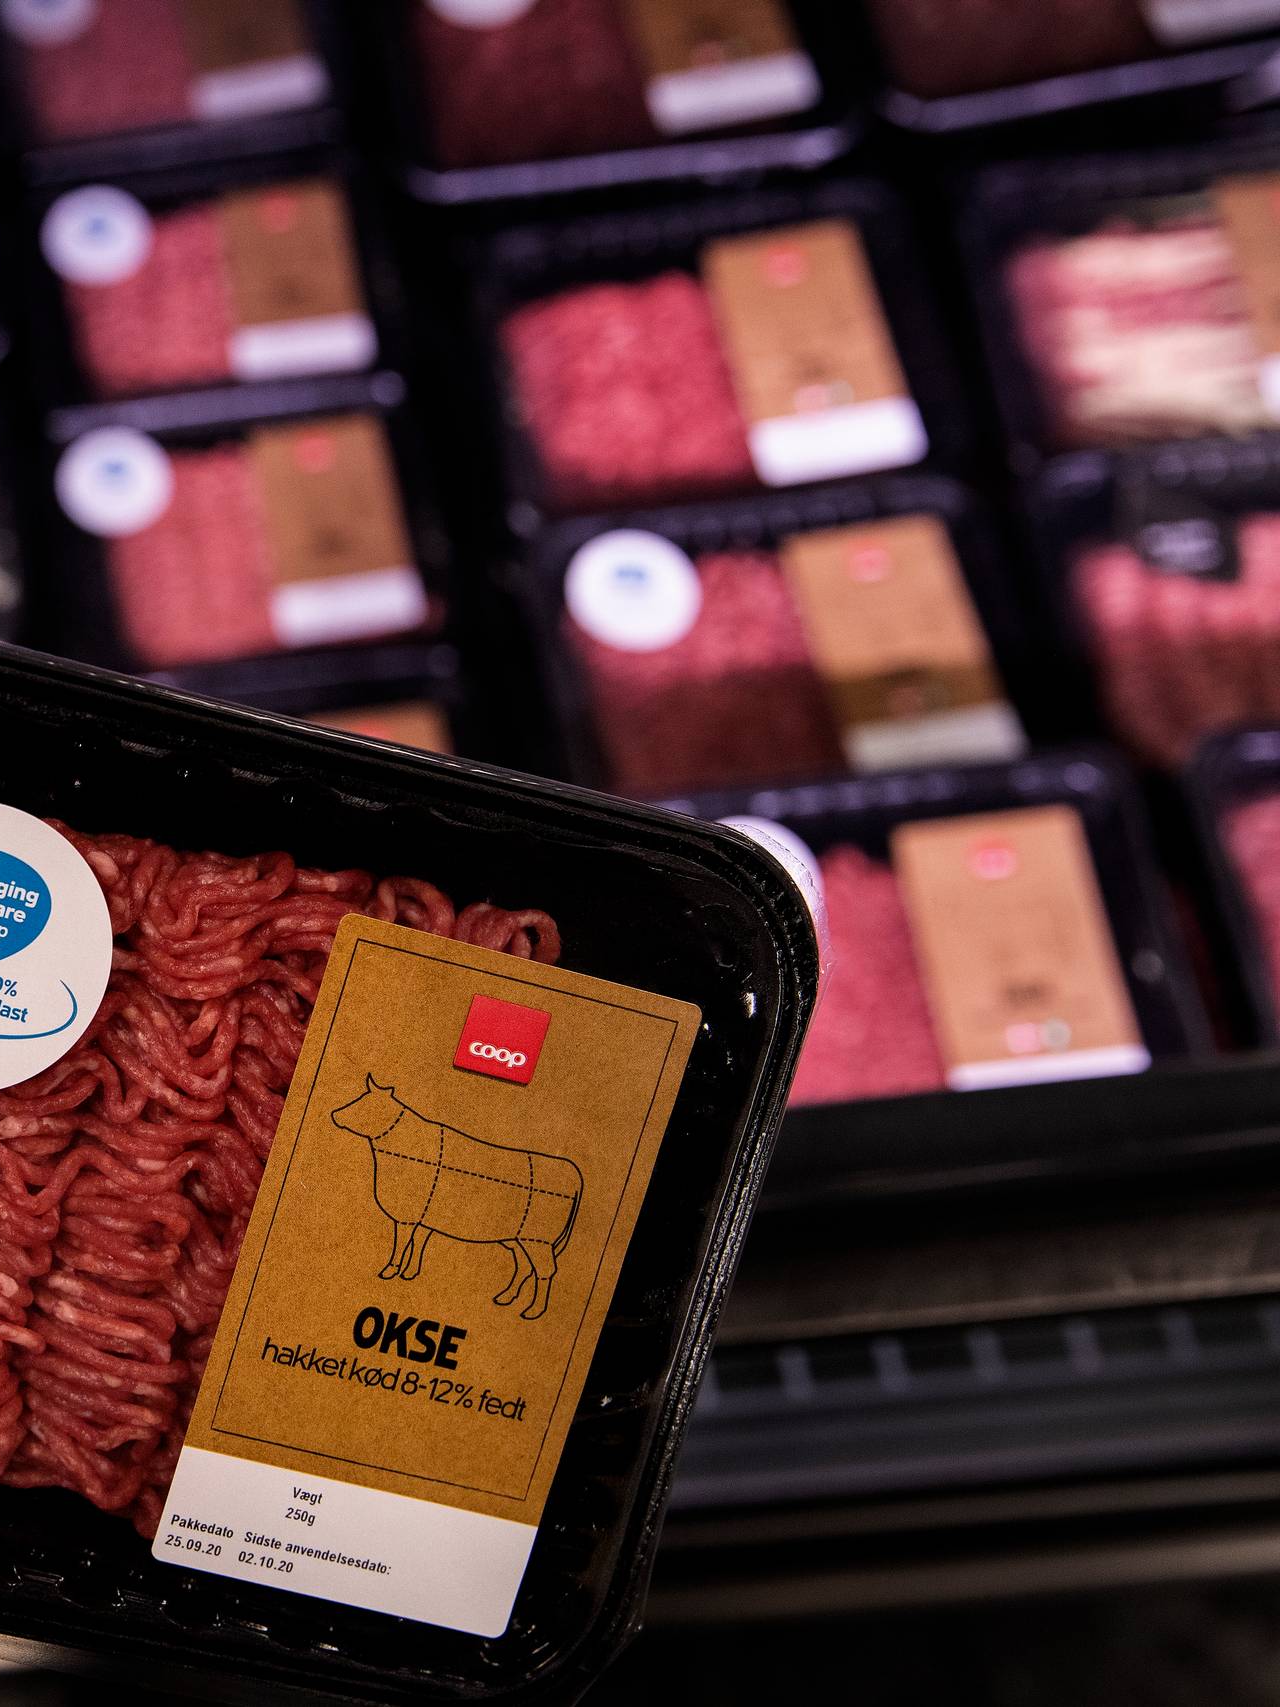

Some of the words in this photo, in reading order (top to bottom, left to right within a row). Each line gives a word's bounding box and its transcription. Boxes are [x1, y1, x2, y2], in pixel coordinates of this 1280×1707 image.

[468, 1040, 527, 1069] coop
[352, 1306, 468, 1371] OKSE
[261, 1337, 348, 1380] hakket
[349, 1364, 400, 1394] kød
[400, 1371, 474, 1409] 8-12%
[477, 1389, 527, 1422] fedt
[292, 1486, 323, 1506] Vægt
[170, 1513, 234, 1540] Pakkedato
[285, 1506, 317, 1526] 250g
[165, 1533, 223, 1557] 25.09.20
[244, 1531, 282, 1551] Sidste
[285, 1541, 393, 1576] anvendelsesdato:
[238, 1550, 294, 1574] 02.10.20
